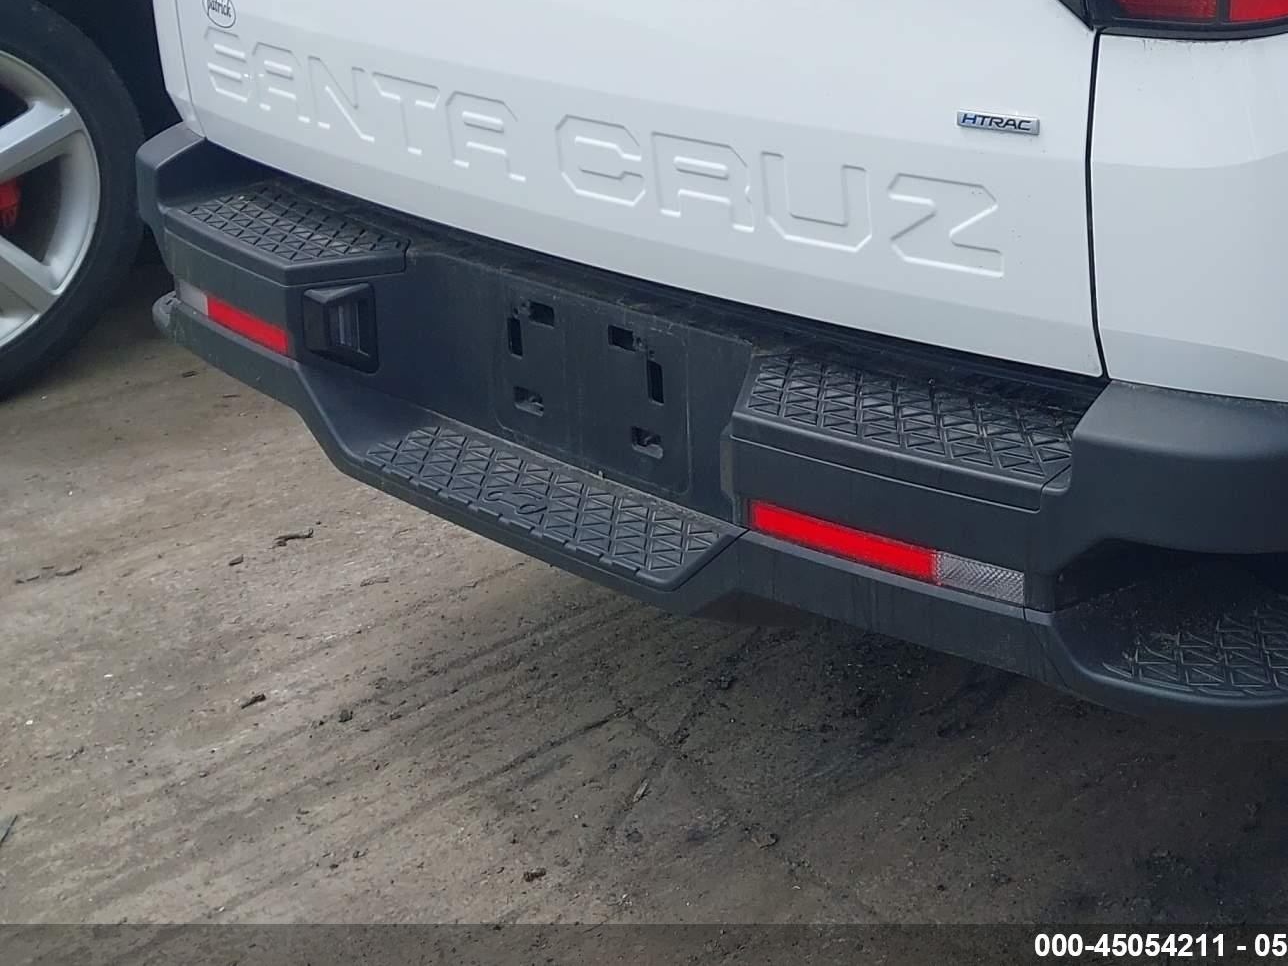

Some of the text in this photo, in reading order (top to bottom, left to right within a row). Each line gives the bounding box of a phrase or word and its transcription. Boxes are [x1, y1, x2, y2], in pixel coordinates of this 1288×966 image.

[203, 25, 1004, 278] SANTA CRUZ
[961, 113, 1031, 131] HTRAC
